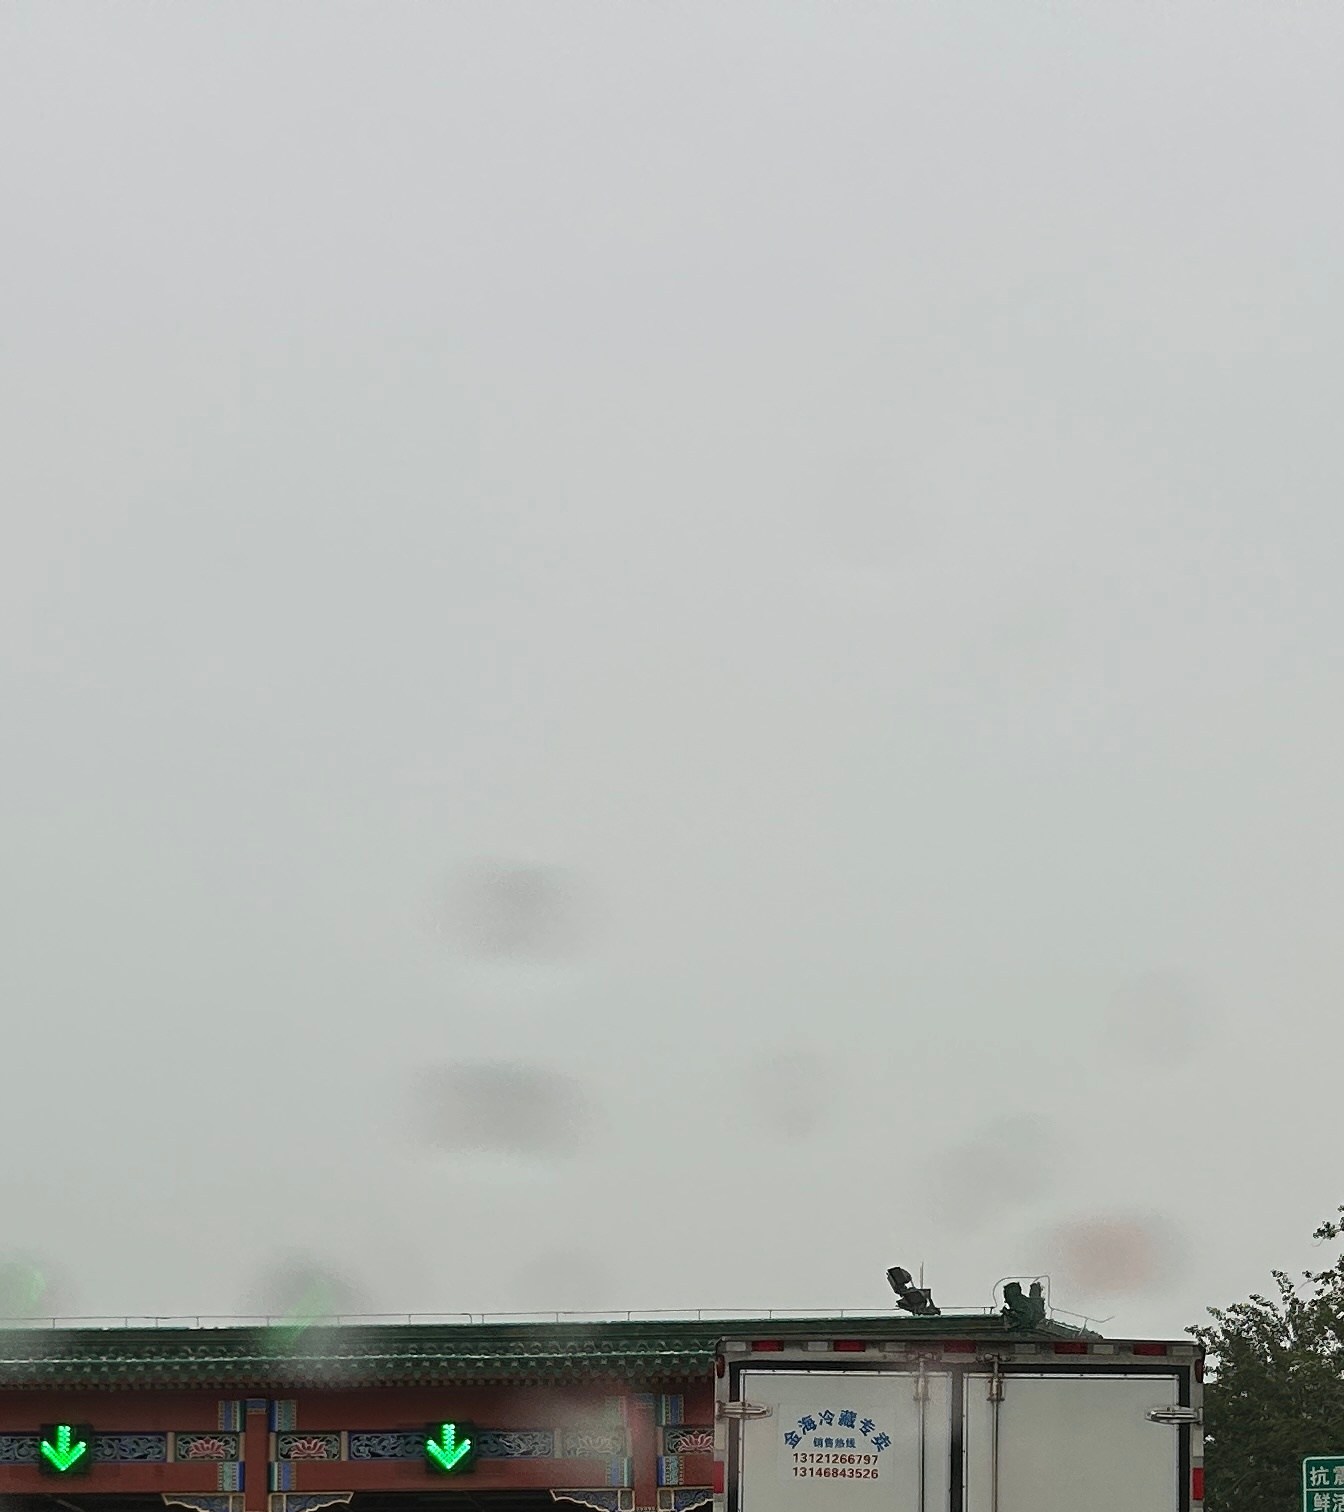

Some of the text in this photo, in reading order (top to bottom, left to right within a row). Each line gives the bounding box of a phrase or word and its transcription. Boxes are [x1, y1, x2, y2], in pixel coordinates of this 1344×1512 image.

[813, 1437, 856, 1449] 销售热线
[792, 1453, 879, 1465] 13121266797
[792, 1467, 879, 1479] 13146843526
